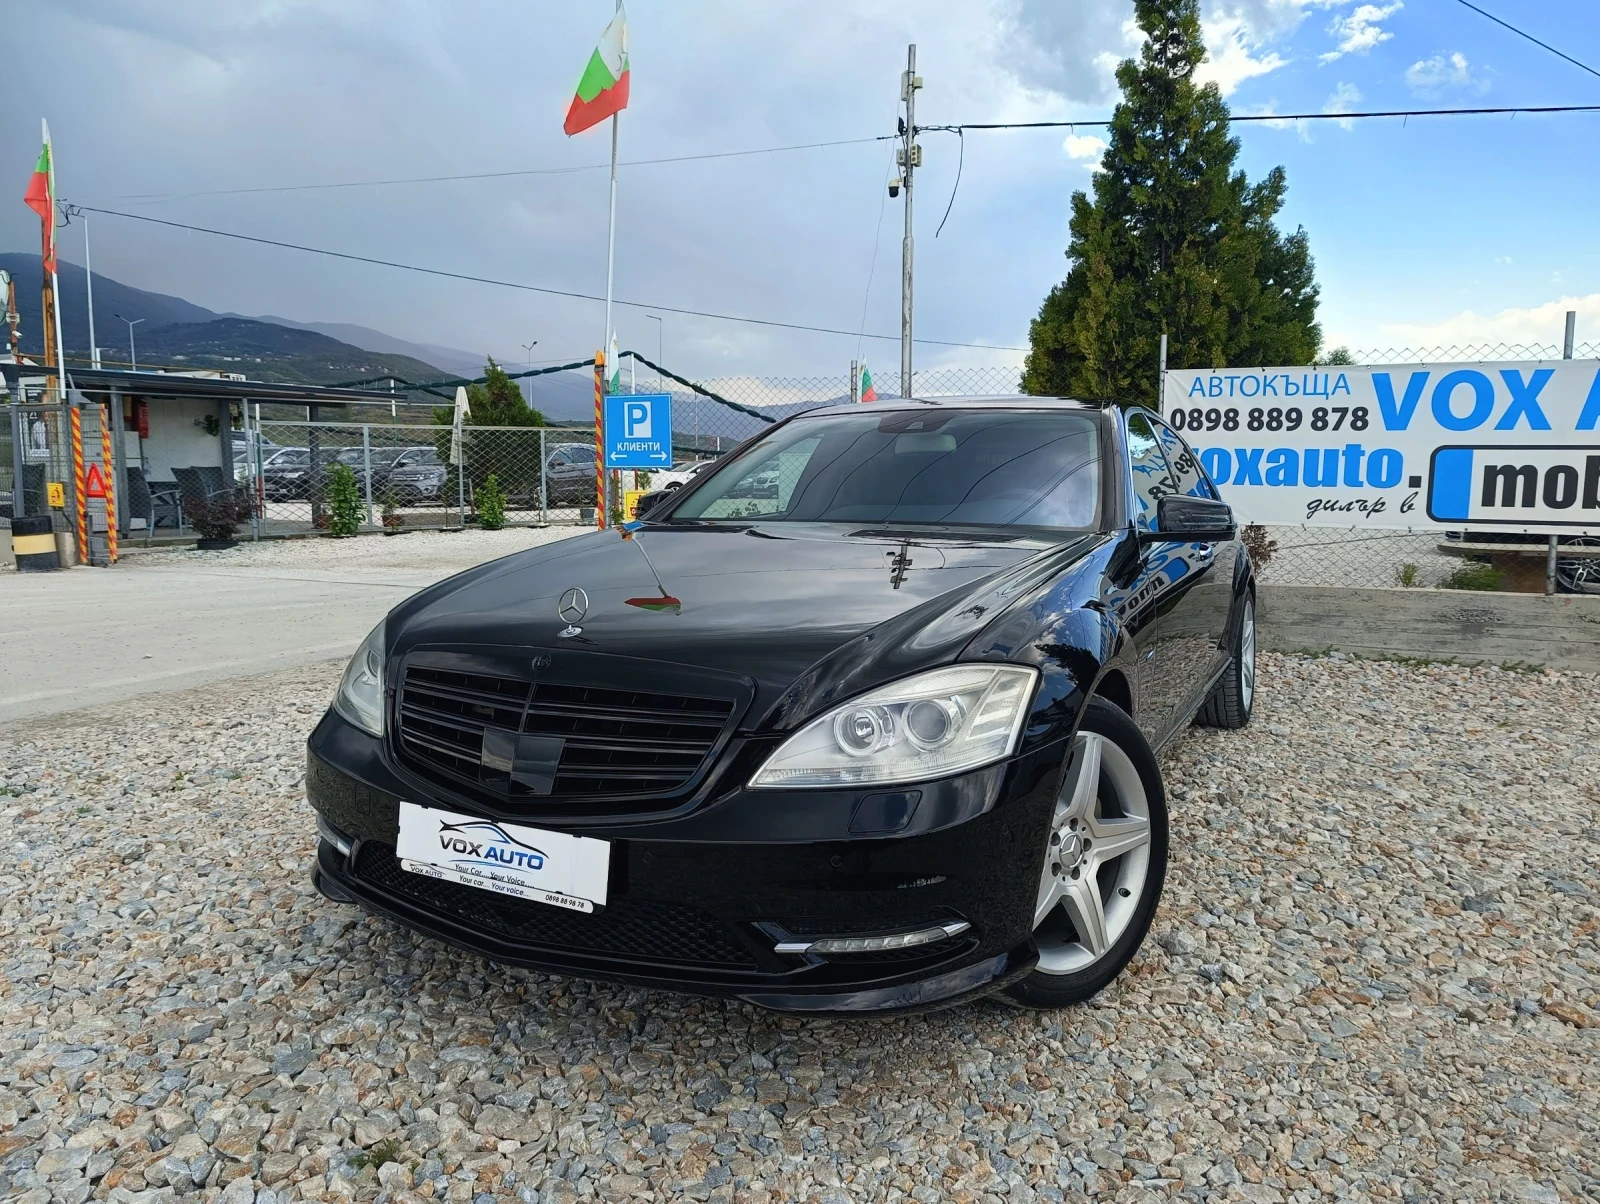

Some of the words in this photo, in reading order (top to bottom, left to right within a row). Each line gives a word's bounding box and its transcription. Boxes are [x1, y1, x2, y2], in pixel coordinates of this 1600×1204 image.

[1188, 373, 1351, 400] АВТОКЪЩА
[1371, 368, 1557, 431] VOX
[628, 403, 648, 436] P
[1170, 407, 1239, 432] 0898
[1247, 406, 1303, 432] 889
[1310, 406, 1369, 431] 878
[617, 441, 660, 452] КЛИЕНТИ
[1306, 496, 1387, 519] дилър
[439, 835, 483, 858] VOX
[484, 846, 544, 870] AUTO
[410, 866, 424, 874] VOX
[425, 869, 442, 878] AUTO
[455, 863, 469, 873] Your
[490, 871, 505, 881] Your
[459, 875, 472, 884] Your
[491, 882, 505, 891] Your
[545, 894, 560, 902] 0898
[560, 897, 568, 905] 88
[568, 899, 576, 907] 98
